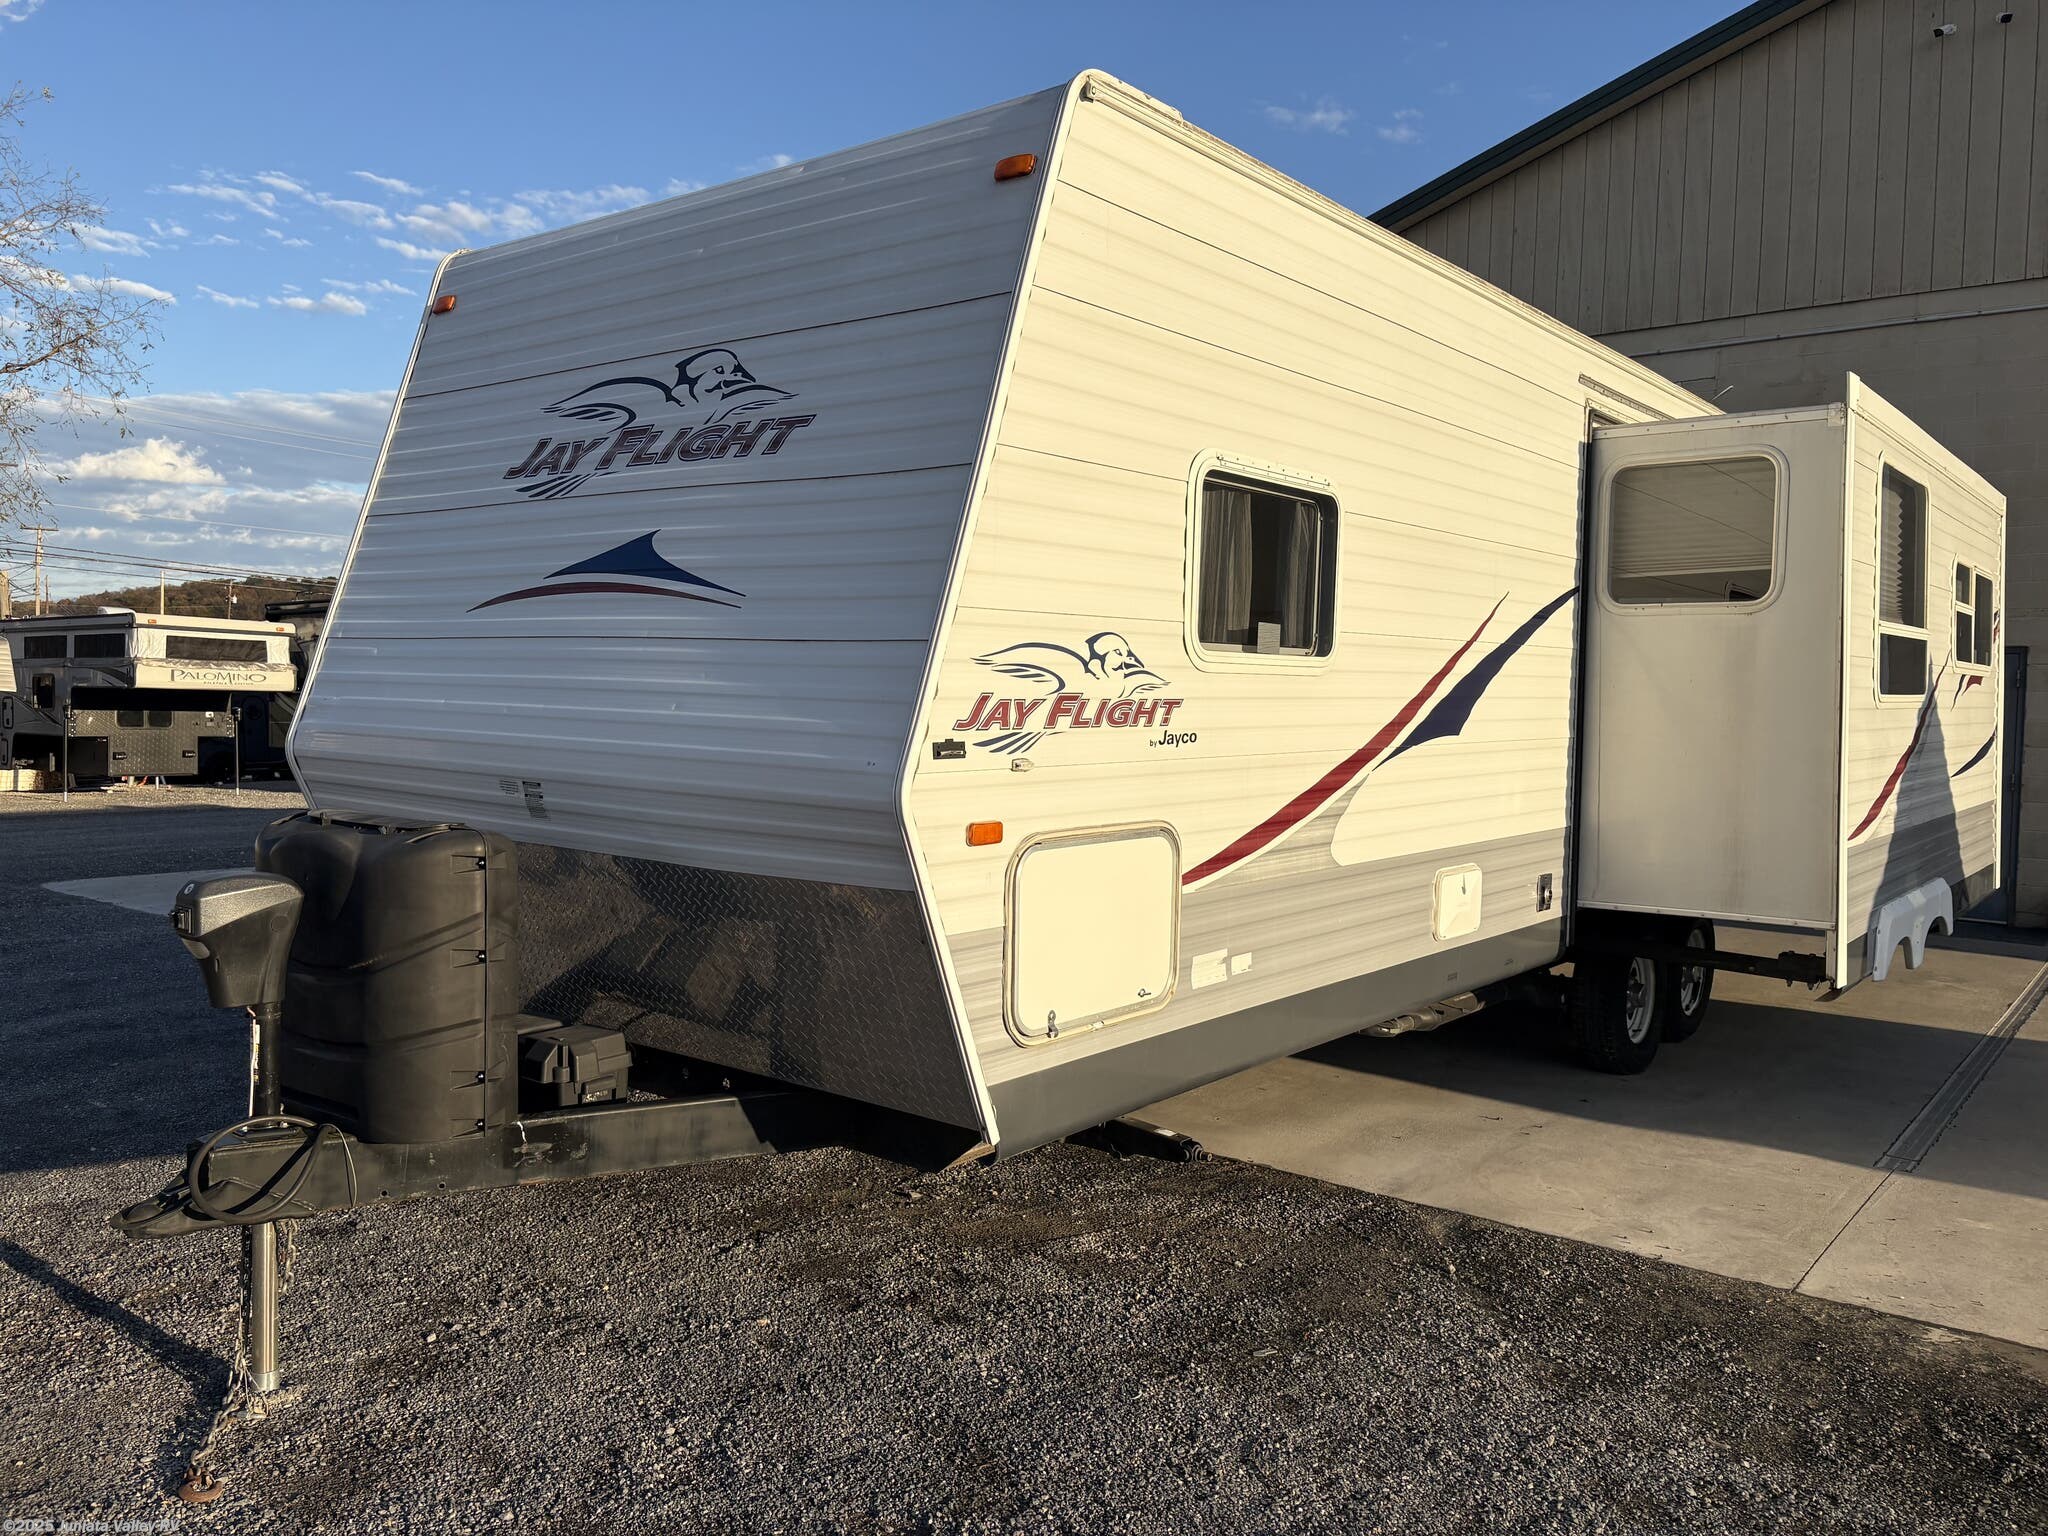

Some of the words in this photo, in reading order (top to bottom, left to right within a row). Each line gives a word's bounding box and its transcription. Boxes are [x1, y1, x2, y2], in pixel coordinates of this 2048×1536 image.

[503, 437, 611, 480] JAY
[595, 413, 818, 471] FLIGHT
[169, 669, 267, 685] PALOMINO
[952, 692, 1047, 731] JAY
[1043, 692, 1185, 730] FLIGHT
[1149, 739, 1158, 748] by
[1158, 730, 1198, 748] Jayco
